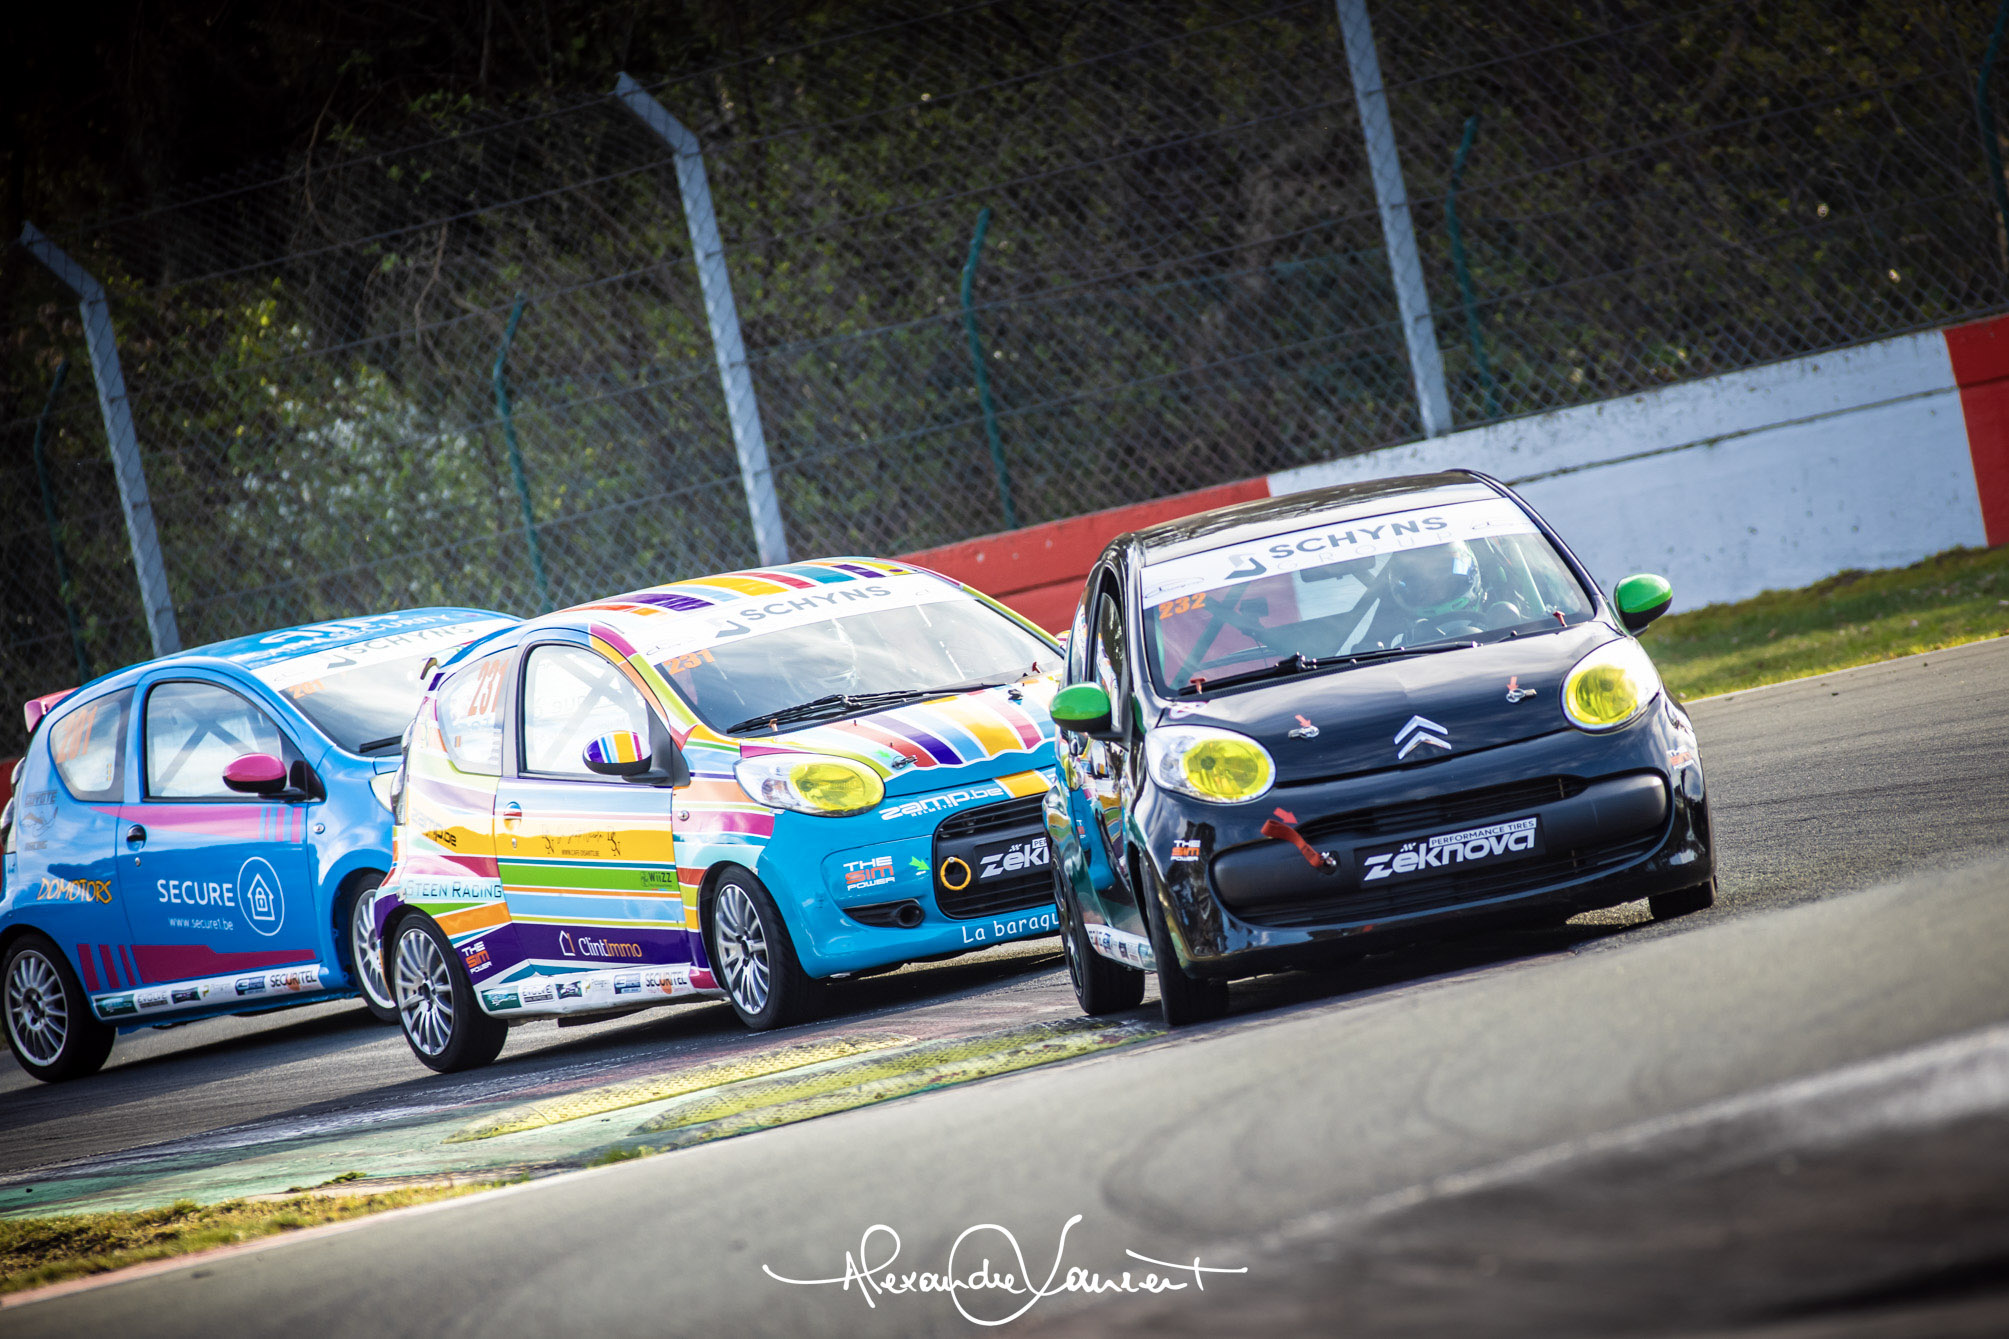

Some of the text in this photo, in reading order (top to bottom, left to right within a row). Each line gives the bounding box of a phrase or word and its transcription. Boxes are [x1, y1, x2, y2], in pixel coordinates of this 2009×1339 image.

[1269, 517, 1447, 558] SCHYNS
[740, 586, 891, 621] SCHYNS
[1158, 592, 1207, 620] 232
[344, 626, 474, 654] SCHYNS
[662, 649, 715, 675] 231
[288, 679, 326, 700] 201
[468, 658, 509, 716] 231
[56, 706, 98, 764] 201
[879, 787, 1004, 820] zamp.be
[1174, 840, 1201, 848] THE
[1431, 820, 1535, 846] PERFORMANCE TIRES
[843, 856, 893, 871] THE
[845, 865, 894, 884] SIM
[37, 878, 112, 904] DOMOTORS
[157, 879, 235, 907] SECURE
[406, 880, 502, 898] STEEN RACING
[847, 877, 896, 891] POWER
[168, 917, 234, 931] www.secure1.be
[962, 926, 986, 944] La
[461, 941, 486, 957] THE
[270, 970, 317, 988] SECURITEL
[645, 971, 688, 988] SECURITEL
